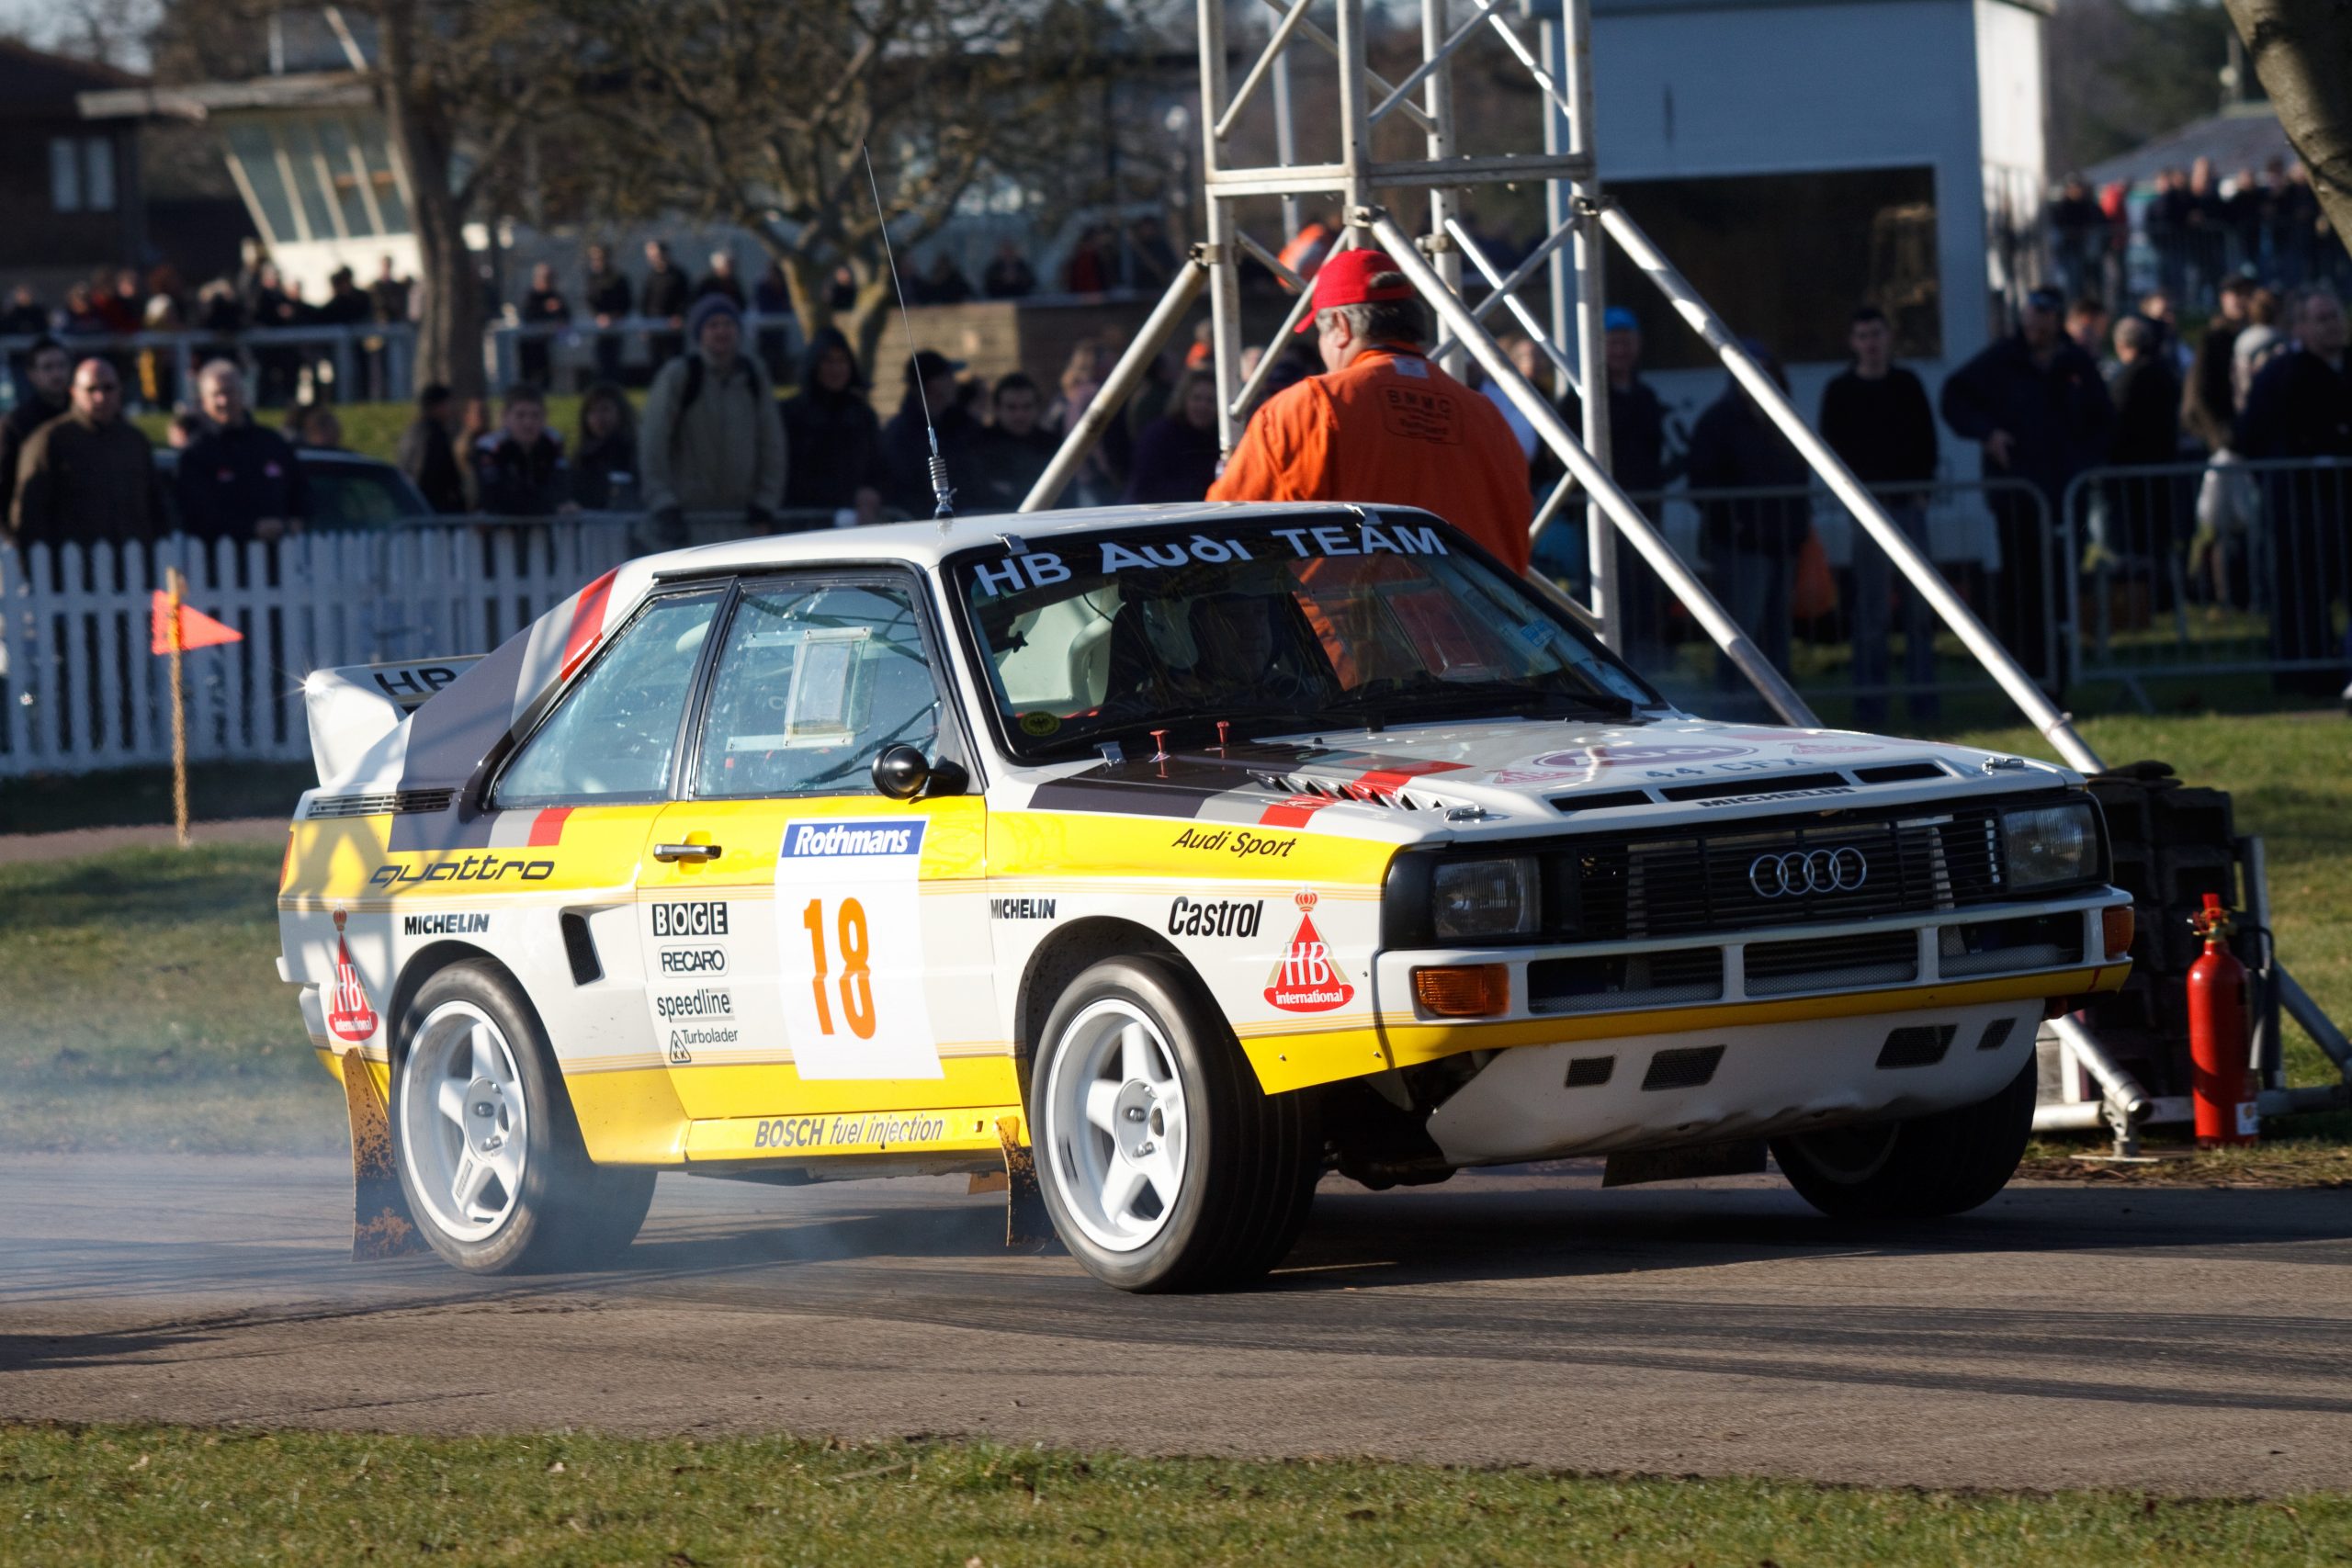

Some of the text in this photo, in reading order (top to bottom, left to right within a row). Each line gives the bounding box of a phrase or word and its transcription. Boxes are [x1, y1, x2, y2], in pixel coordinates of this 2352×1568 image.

[974, 553, 1072, 595] HB
[1272, 525, 1449, 558] TEAM
[1697, 787, 1857, 808] MICHELIN
[794, 825, 910, 855] Rothmans
[1171, 829, 1297, 858] Audi Sport
[370, 854, 555, 888] quattro
[404, 913, 490, 935] MICHELIN
[653, 903, 728, 936] BOGE
[990, 898, 1057, 919] MICHELIN
[1168, 896, 1264, 938] Castrol
[661, 949, 725, 972] RECARO
[803, 897, 876, 1040] 18
[1284, 942, 1330, 987] HB
[335, 964, 363, 1012] HB
[1274, 988, 1343, 1005] international
[657, 988, 731, 1022] speedline
[334, 1016, 373, 1032] international
[681, 1028, 738, 1044] Turbolader
[754, 1113, 944, 1147] BOSCH fuel injection
